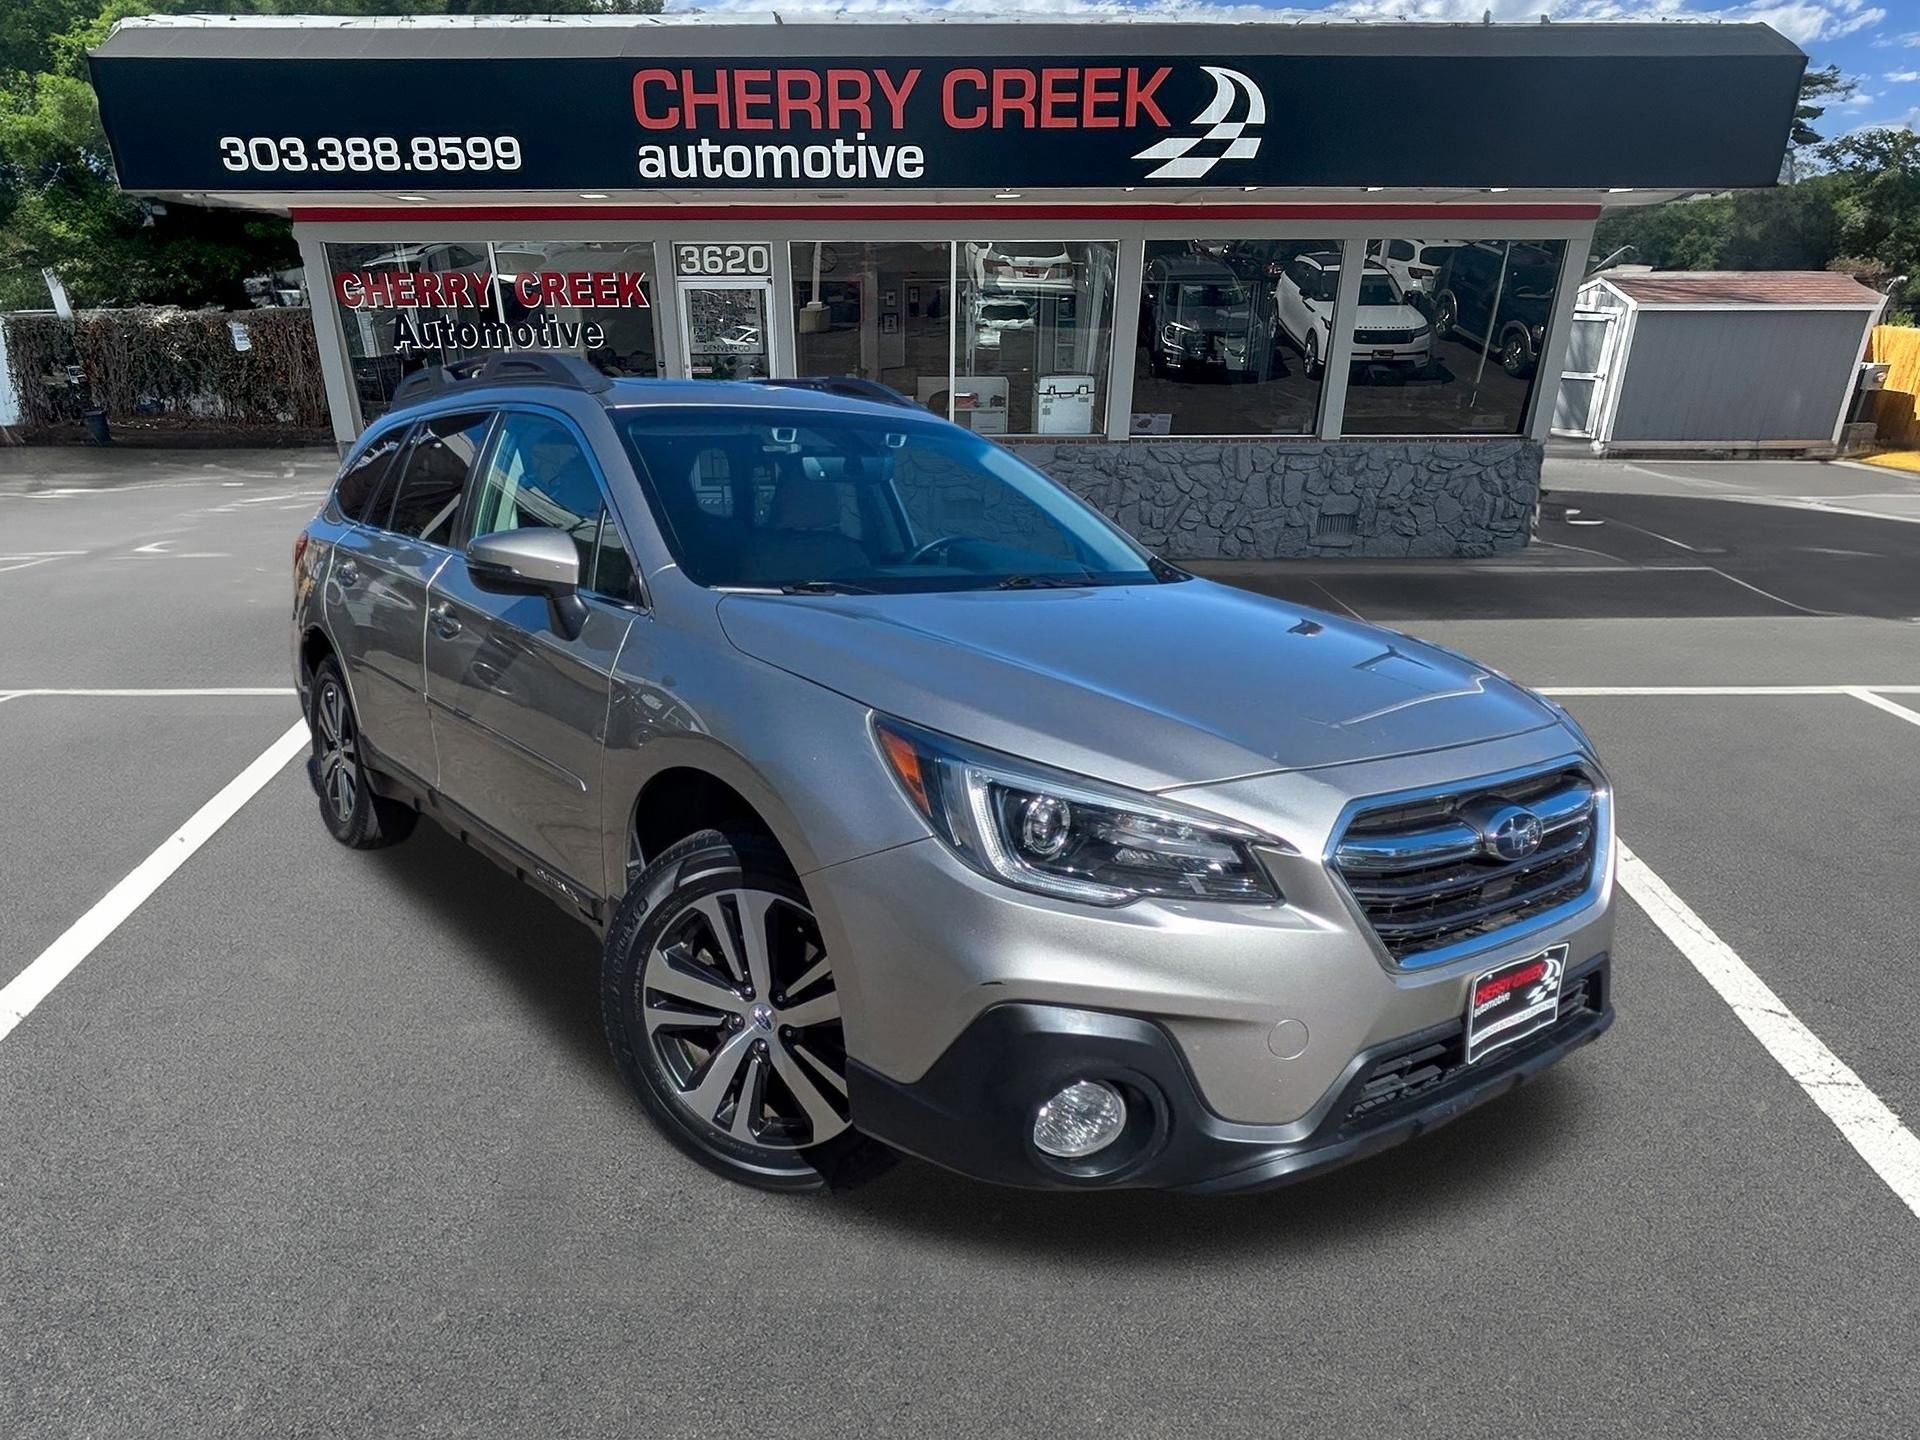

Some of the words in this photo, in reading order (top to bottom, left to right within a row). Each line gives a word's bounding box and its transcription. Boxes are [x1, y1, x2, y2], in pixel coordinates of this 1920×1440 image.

[632, 68, 922, 131] CHERRY
[941, 66, 1174, 130] CREEK
[219, 136, 522, 172] 303.388.8599
[637, 132, 925, 180] automotive
[679, 245, 769, 275] 3620
[335, 271, 493, 309] CHERRY
[514, 271, 650, 308] CREEK
[394, 313, 605, 350] Automotive
